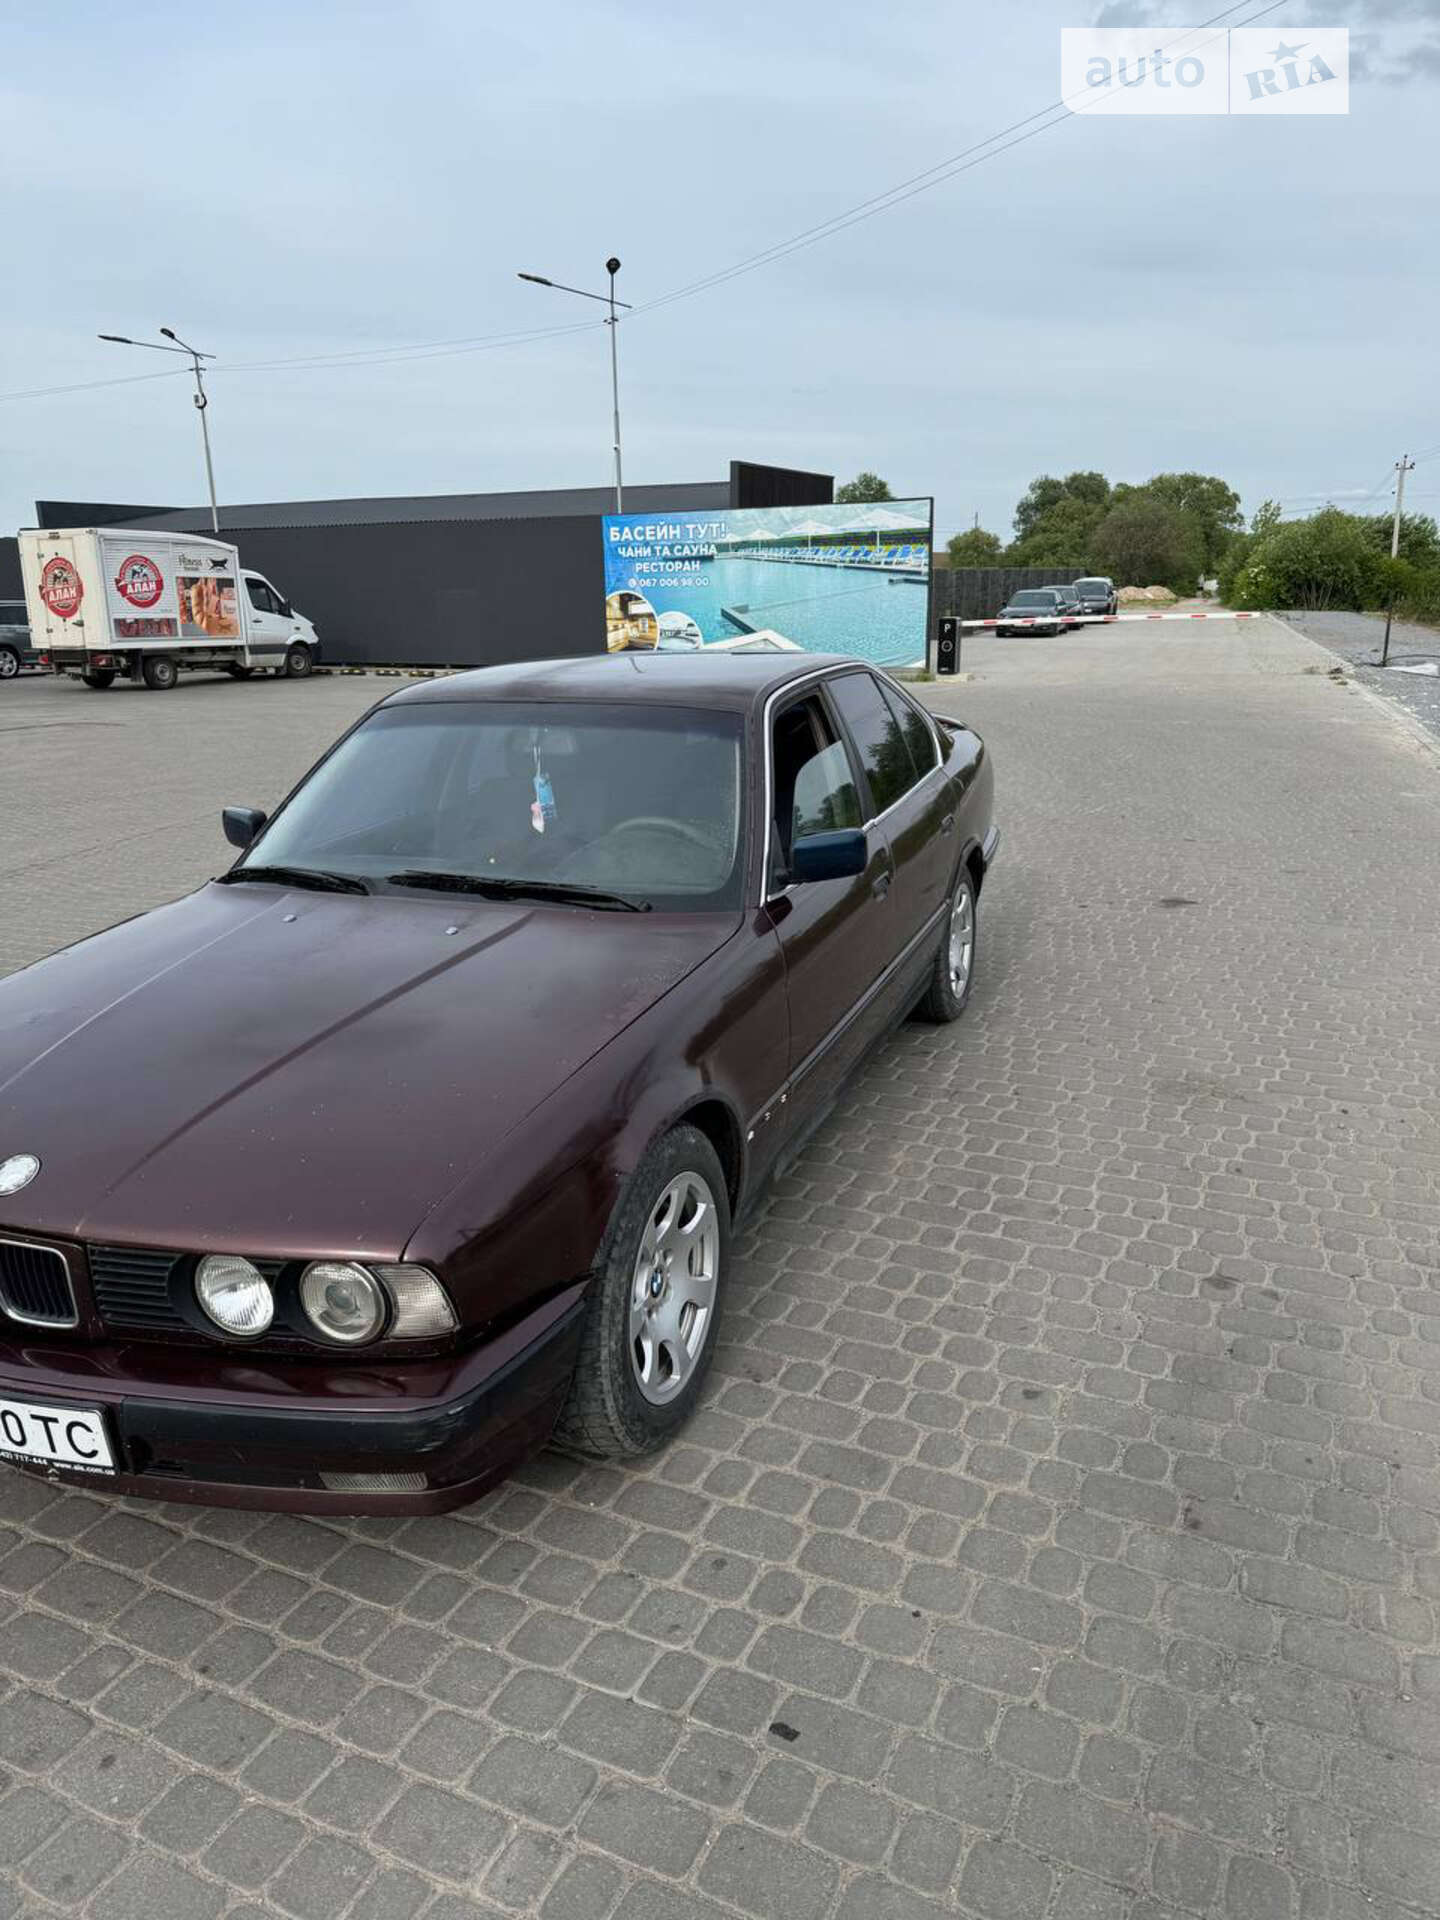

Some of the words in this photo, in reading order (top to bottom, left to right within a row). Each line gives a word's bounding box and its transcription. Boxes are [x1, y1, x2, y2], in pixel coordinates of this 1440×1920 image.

[609, 521, 681, 541] БАСЕЙН
[685, 523, 726, 539] ТУТ!
[618, 546, 651, 558] ЧАНИ
[654, 545, 671, 557] ТА
[673, 543, 718, 557] САУНА
[635, 560, 701, 573] РЕСТОРАН
[126, 581, 157, 595] АЛАН
[695, 576, 709, 586] 00
[47, 586, 77, 601] АЛАН
